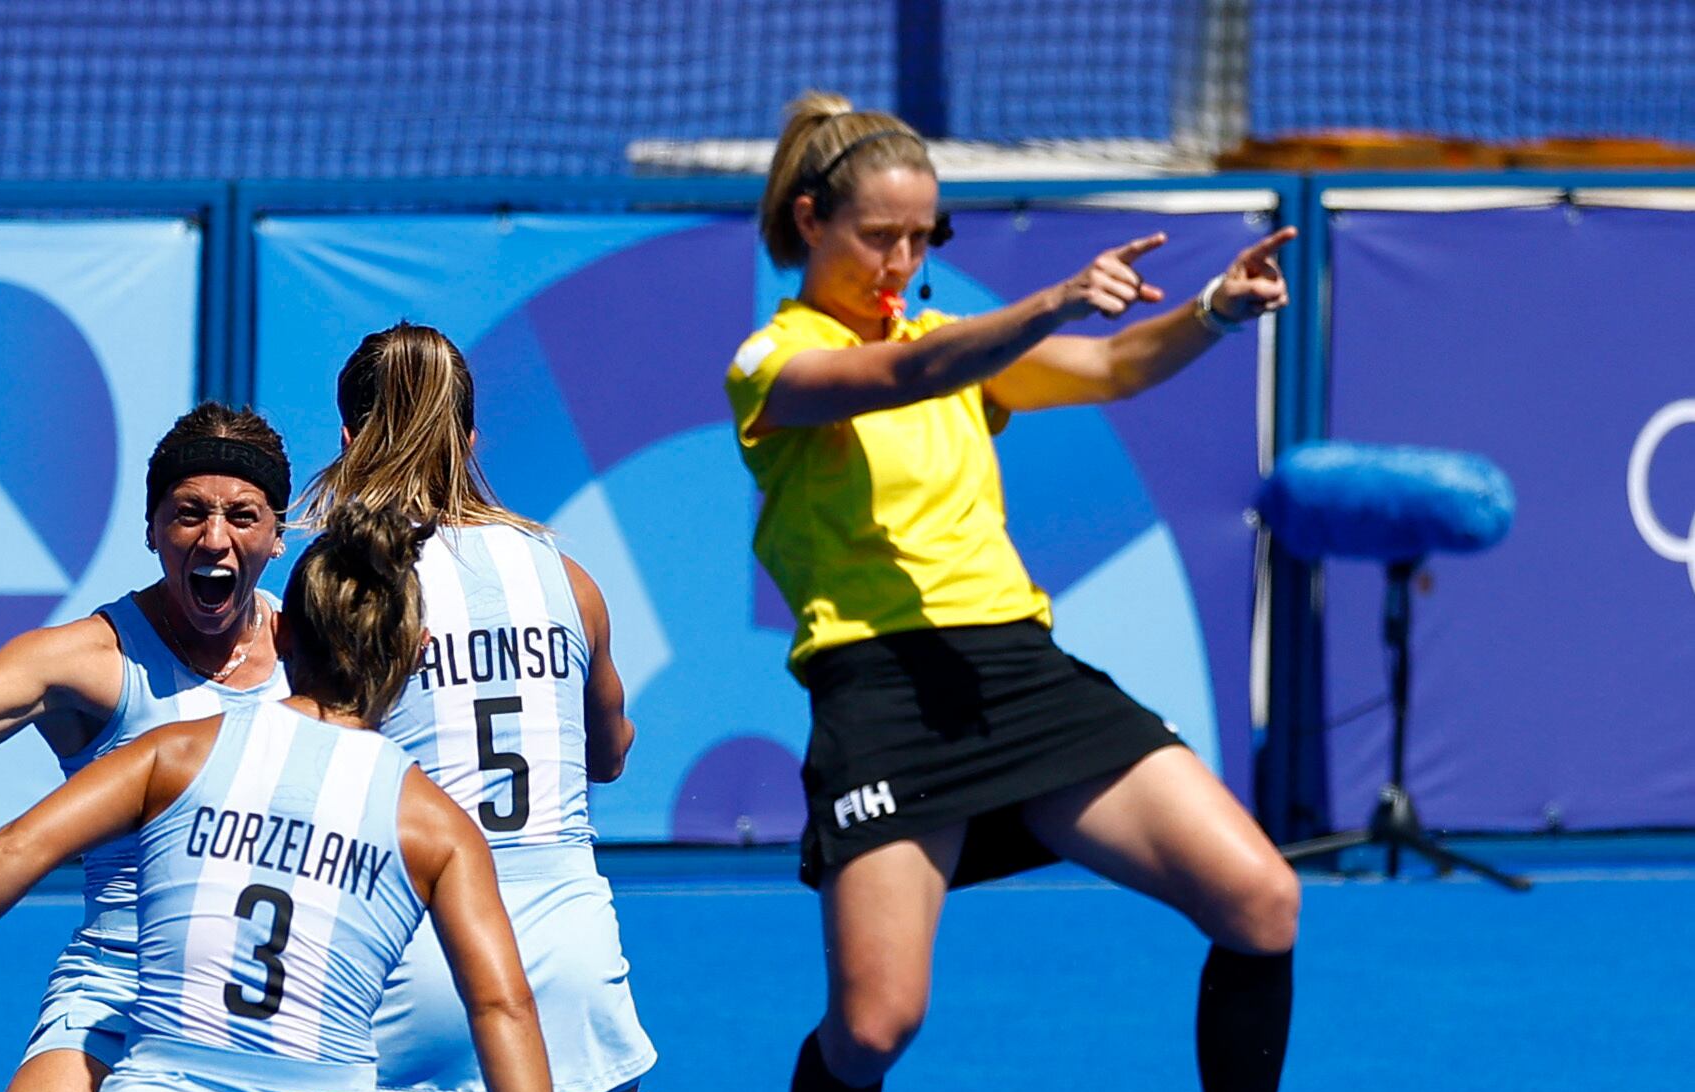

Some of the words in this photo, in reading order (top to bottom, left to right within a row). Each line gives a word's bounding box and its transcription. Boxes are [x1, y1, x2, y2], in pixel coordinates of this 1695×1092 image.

[419, 626, 569, 690] ALONSO
[473, 695, 529, 832] 5
[833, 780, 897, 829] FIH
[186, 806, 392, 901] GORZELANY
[223, 883, 294, 1020] 3
